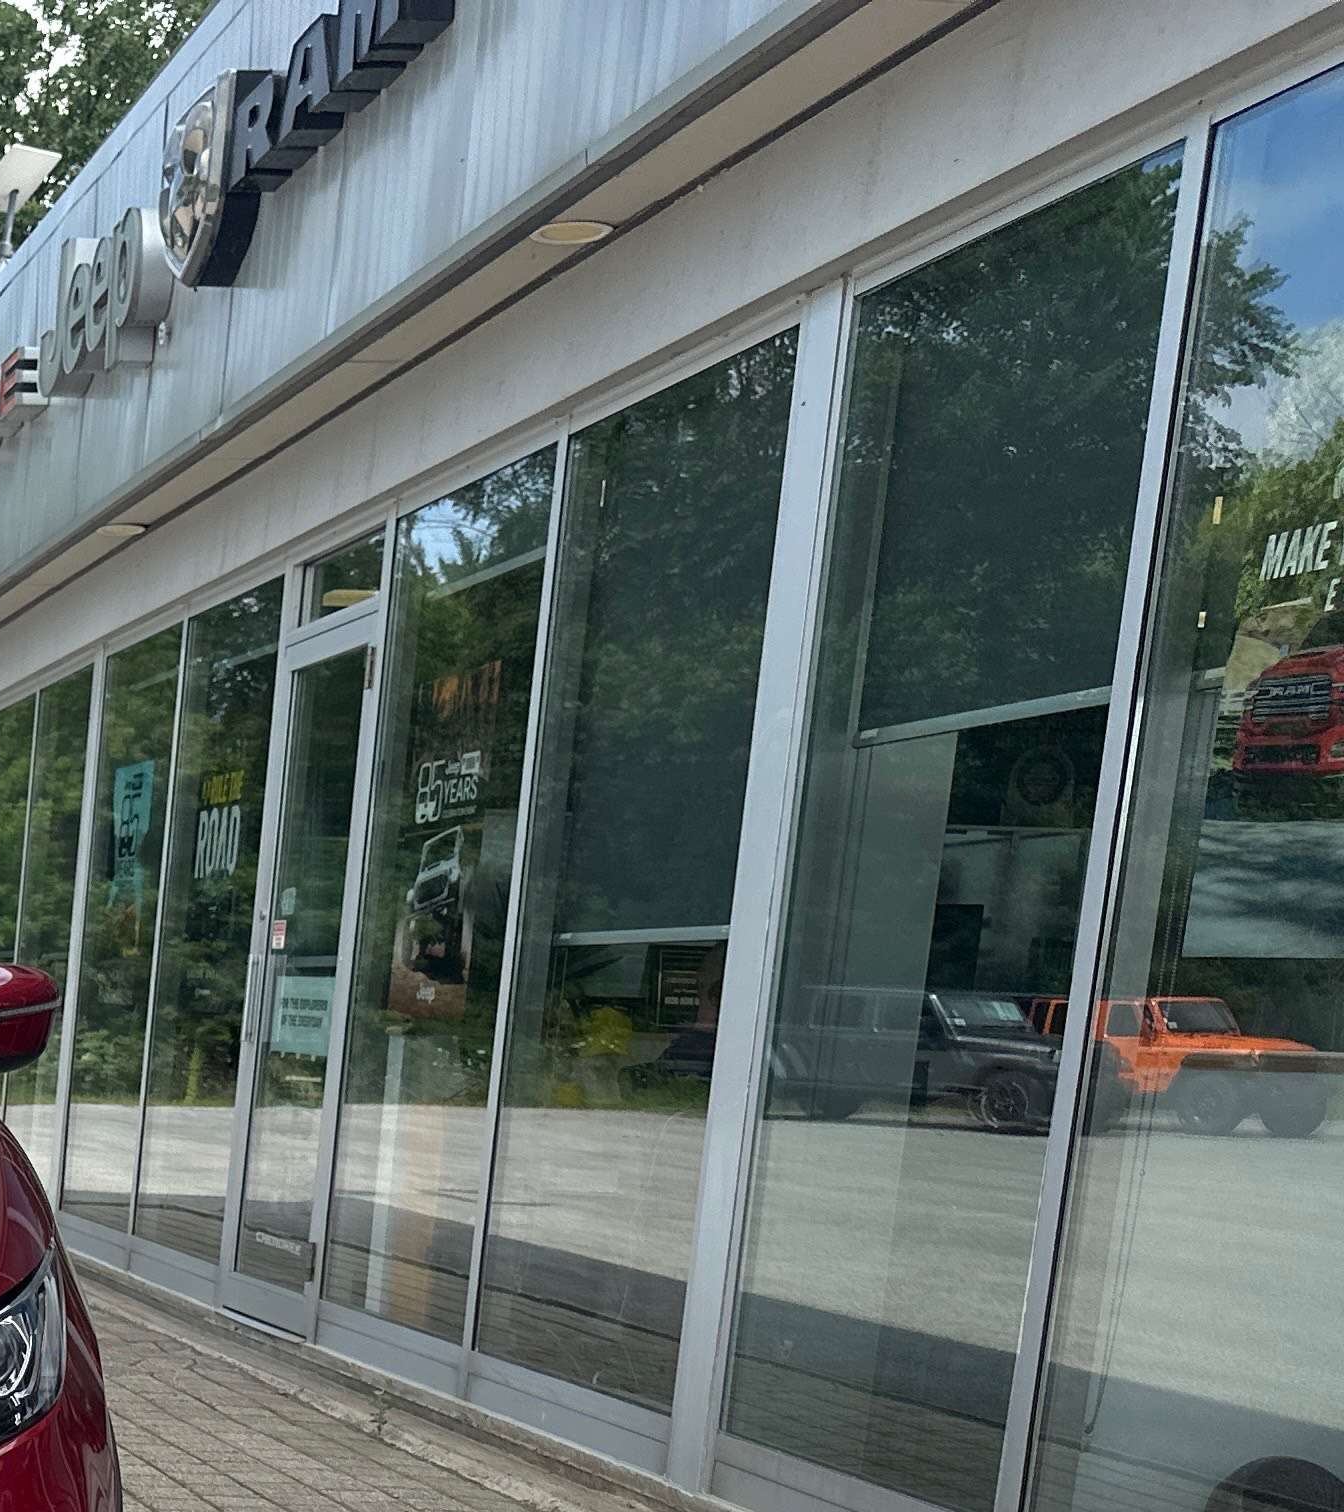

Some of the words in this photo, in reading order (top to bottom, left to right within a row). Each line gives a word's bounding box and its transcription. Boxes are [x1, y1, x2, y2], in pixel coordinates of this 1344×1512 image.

[229, 0, 404, 192] RAM
[39, 207, 145, 398] Jeep
[1259, 520, 1339, 582] MAKE
[443, 775, 480, 803] YEARS
[194, 805, 241, 879] ROAD
